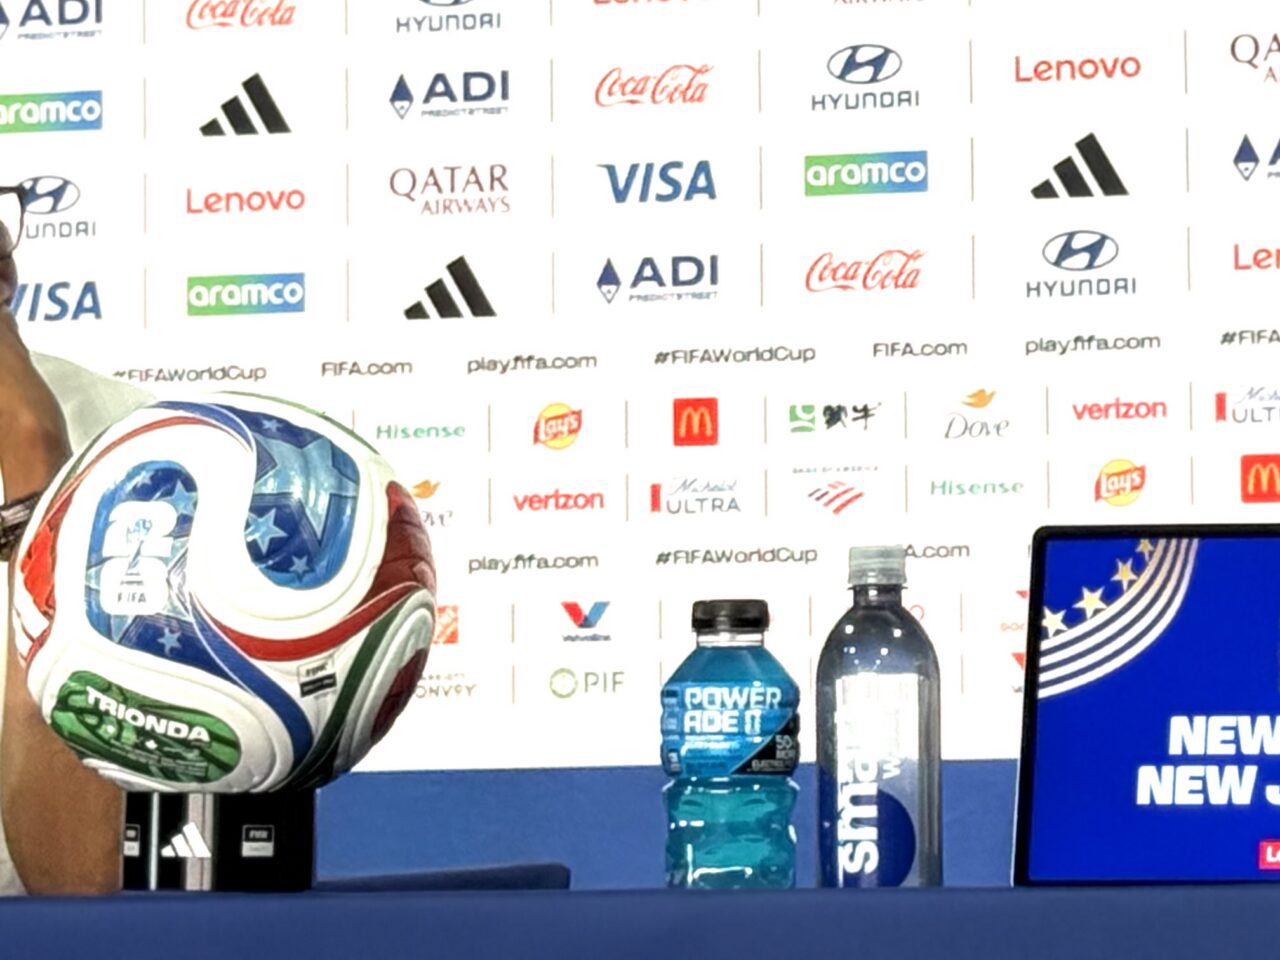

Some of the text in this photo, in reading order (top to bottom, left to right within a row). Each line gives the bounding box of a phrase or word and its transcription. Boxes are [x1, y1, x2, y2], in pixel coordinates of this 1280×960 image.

[395, 12, 501, 33] HYUNDAI
[1014, 55, 1142, 83] Lenovo
[422, 69, 510, 105] ADI
[594, 63, 713, 108] Coca-Cola
[811, 90, 920, 111] HYUNDAI
[389, 163, 509, 201] QATAR
[597, 159, 717, 204] VISA
[806, 164, 925, 187] aramco
[186, 188, 306, 215] Lenovo
[421, 196, 511, 216] AIRWAYS
[26, 221, 96, 238] UNDAI
[629, 254, 719, 289] ADI
[804, 249, 925, 293] Coca-Cola
[189, 283, 303, 308] aramco
[1025, 277, 1137, 298] HYUNDAI
[653, 345, 816, 365] #FIFAWorldCup
[872, 341, 968, 358] FIFA.com
[1025, 334, 1161, 356] play.fifa.com
[320, 360, 413, 377] FIFA.com
[466, 354, 598, 375] play.fifa.com
[1071, 396, 1168, 421] verizon
[375, 424, 466, 440] Hisense
[943, 415, 1010, 440] Dove
[930, 479, 1024, 496] Hisense
[512, 488, 605, 512] verizon
[665, 497, 741, 515] ULTRA
[655, 546, 818, 566] #FIFAWorldCup
[904, 544, 970, 558] A.com
[468, 553, 599, 575] play.fifa.com
[415, 683, 476, 698] ONVOY
[583, 670, 625, 693] PIF
[684, 681, 781, 710] POWER
[86, 685, 210, 742] TRIONDA
[683, 709, 740, 734] ADE
[1136, 765, 1258, 805] NEW
[841, 759, 879, 874] sma
